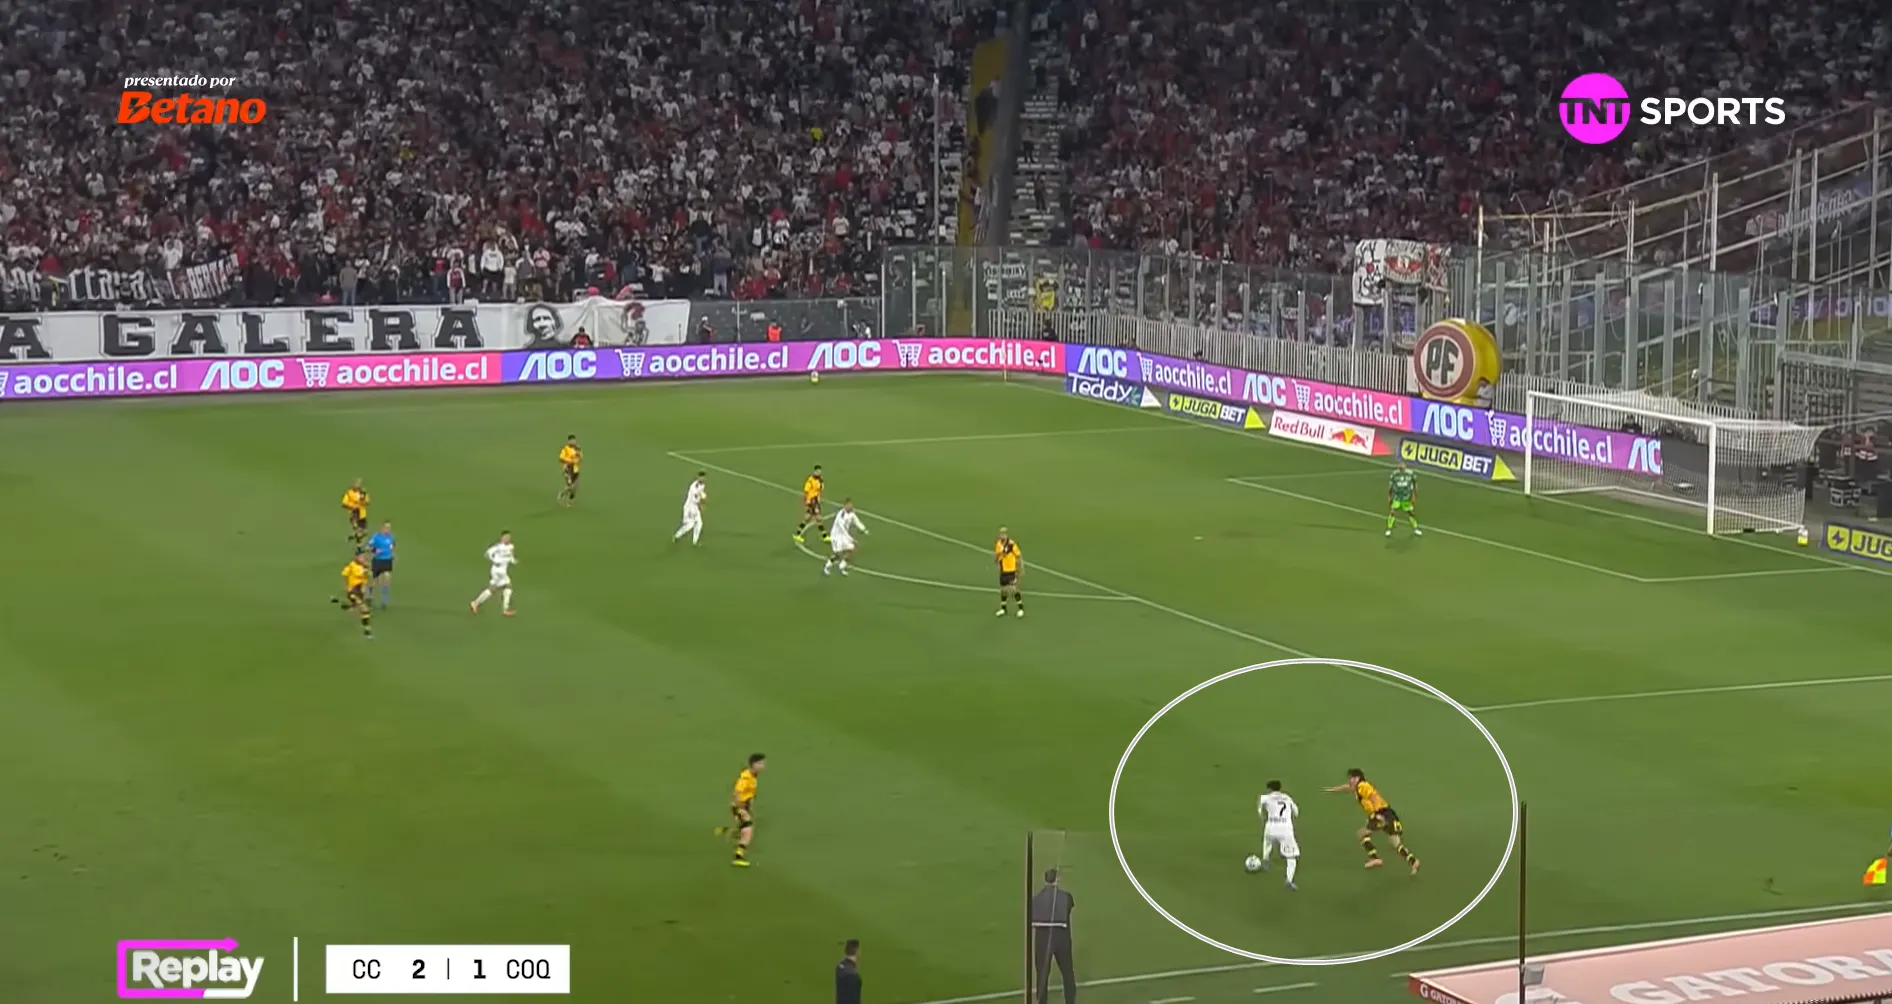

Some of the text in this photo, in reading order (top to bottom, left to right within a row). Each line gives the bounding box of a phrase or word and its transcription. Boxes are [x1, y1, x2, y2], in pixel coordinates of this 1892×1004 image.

[0, 306, 484, 360] A GALERA
[13, 341, 1056, 394] aocchile.cl AOC aocchile.cl AOC aocchile.cl AOC aocchile.cl
[1426, 337, 1459, 385] PF
[1068, 373, 1133, 405] Teddy
[1078, 347, 1127, 377] AOC
[1155, 363, 1232, 395] aocchile.cl
[1242, 373, 1286, 407] AOC
[1314, 389, 1403, 424] aocchile.cl
[1422, 403, 1474, 440] AOC
[1509, 424, 1613, 464] aocchile.cl
[1274, 416, 1326, 439] Red Bull
[1277, 801, 1286, 817] 7
